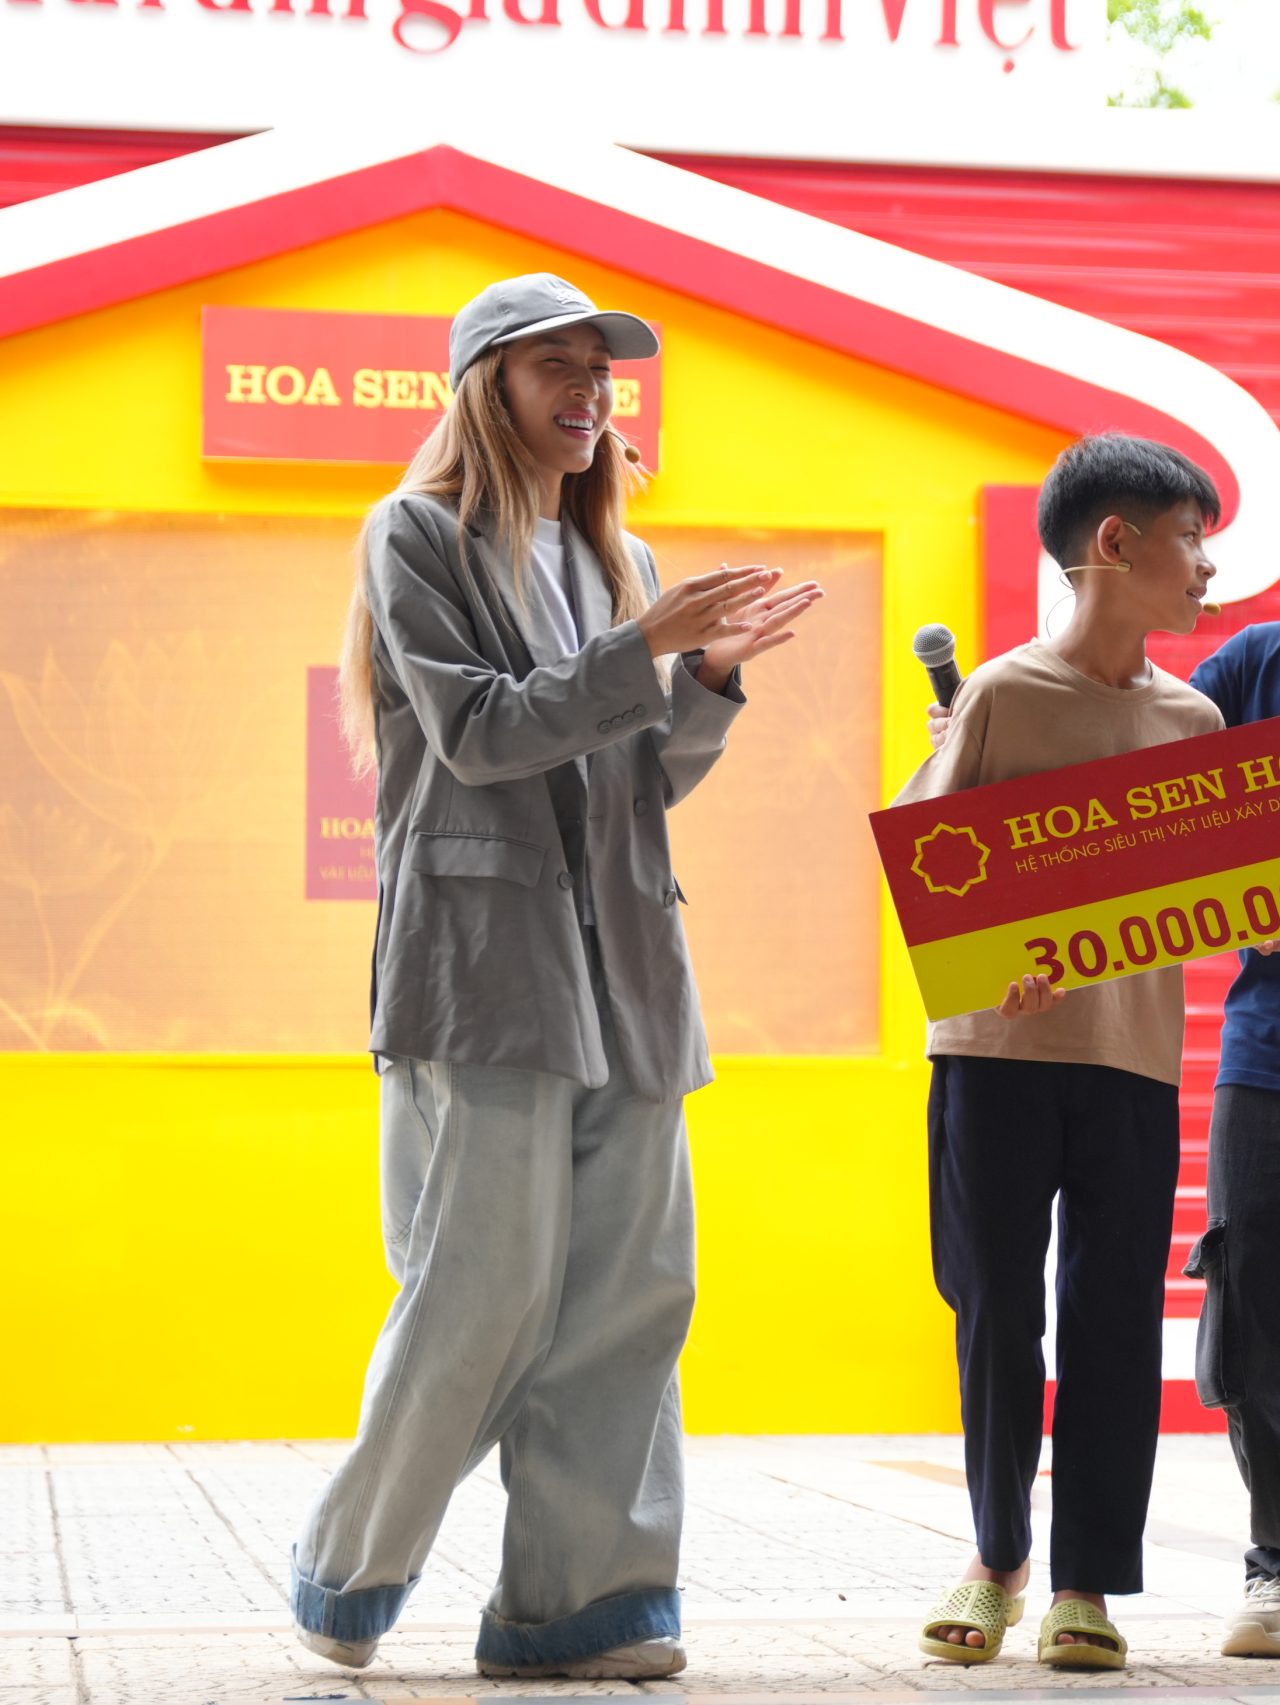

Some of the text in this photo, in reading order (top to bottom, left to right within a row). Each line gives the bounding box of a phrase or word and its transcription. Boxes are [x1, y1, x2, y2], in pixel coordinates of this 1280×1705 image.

[225, 364, 341, 407] HOA
[1003, 798, 1118, 850] HOA
[1126, 768, 1227, 821] SEN
[1015, 854, 1039, 874] HỆ
[1039, 843, 1100, 867] THỐNG
[1104, 833, 1137, 853] SIÊU
[1139, 825, 1166, 844] THỊ
[1167, 818, 1196, 837] VẬT
[1201, 811, 1231, 829] LIỆU
[1234, 802, 1265, 821] XÂY
